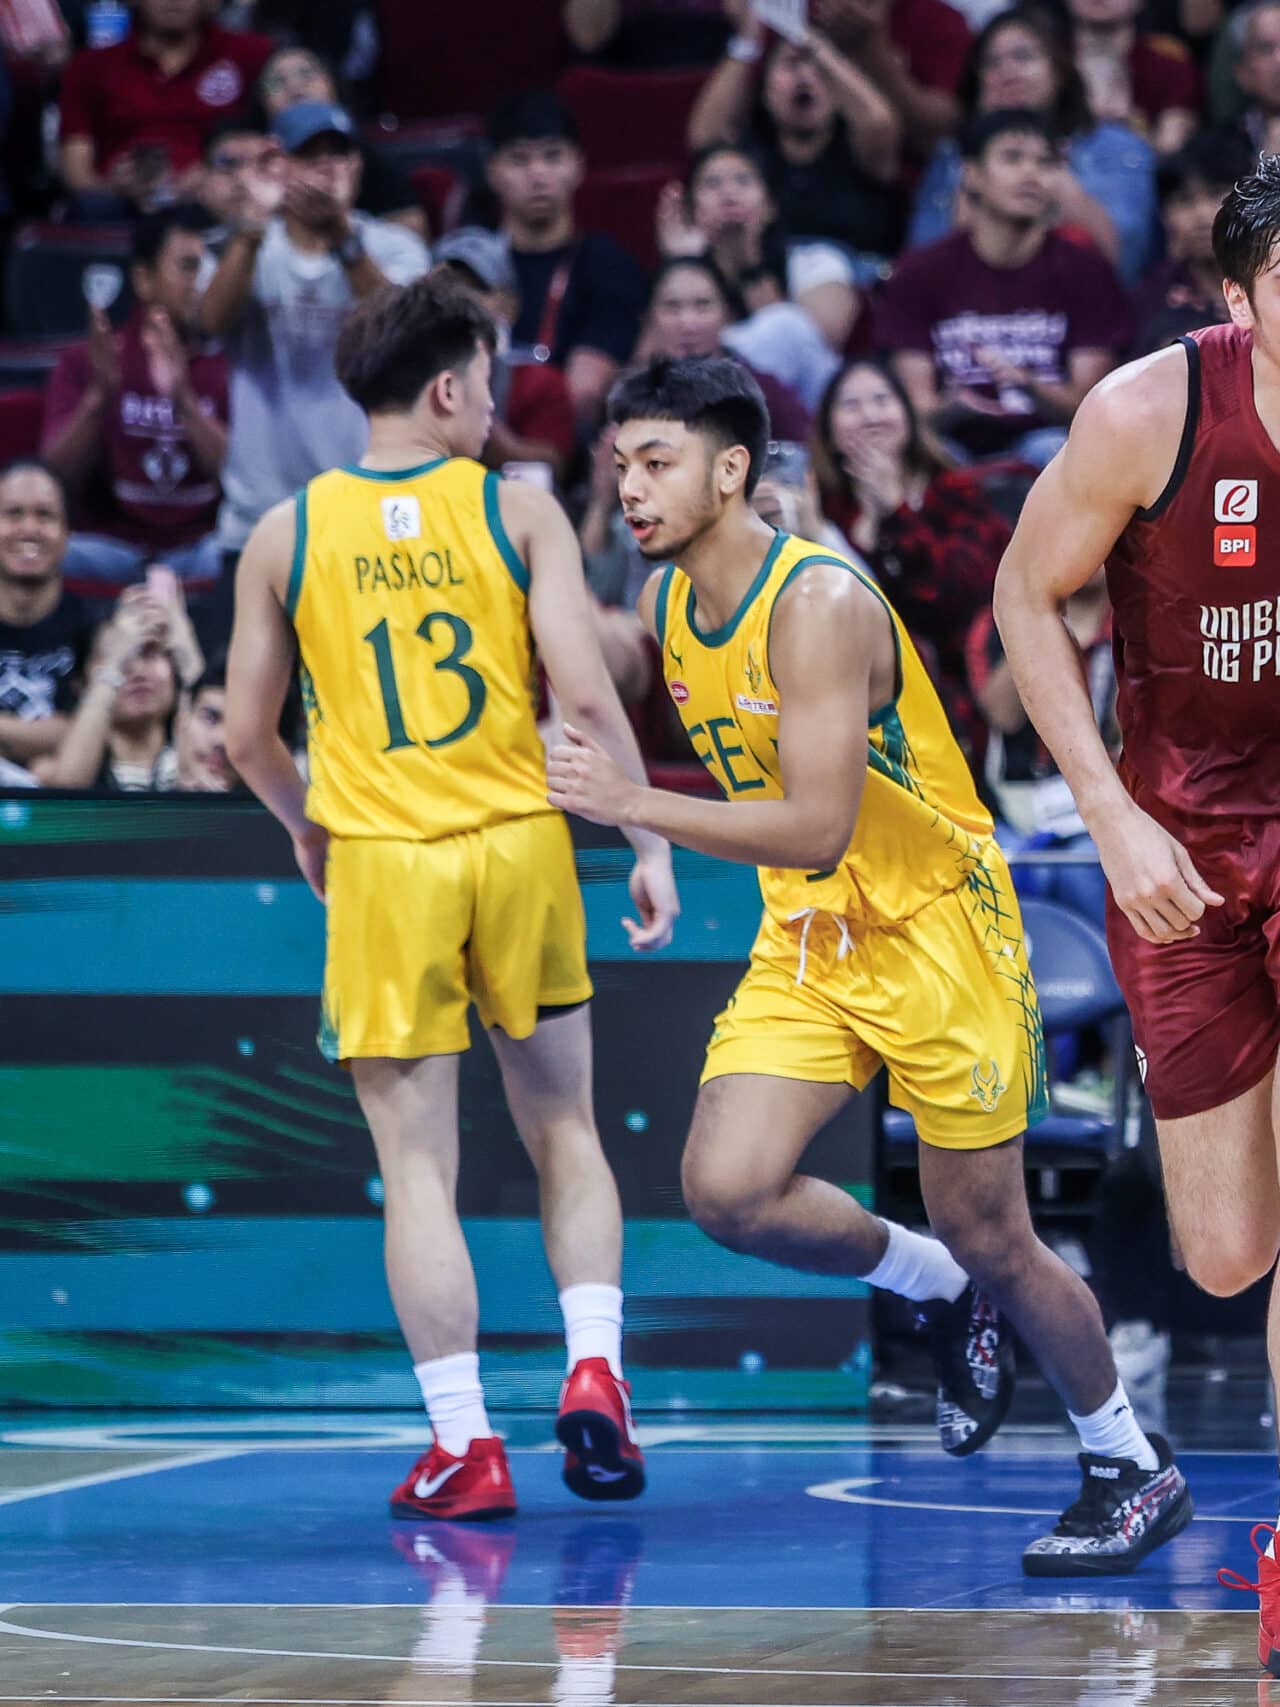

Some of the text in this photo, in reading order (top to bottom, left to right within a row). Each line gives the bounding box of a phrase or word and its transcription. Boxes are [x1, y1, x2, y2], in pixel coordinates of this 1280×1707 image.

[1220, 539, 1250, 553] BPI
[354, 548, 465, 593] PASAOL
[364, 611, 487, 753] 13
[1202, 641, 1240, 682] NG
